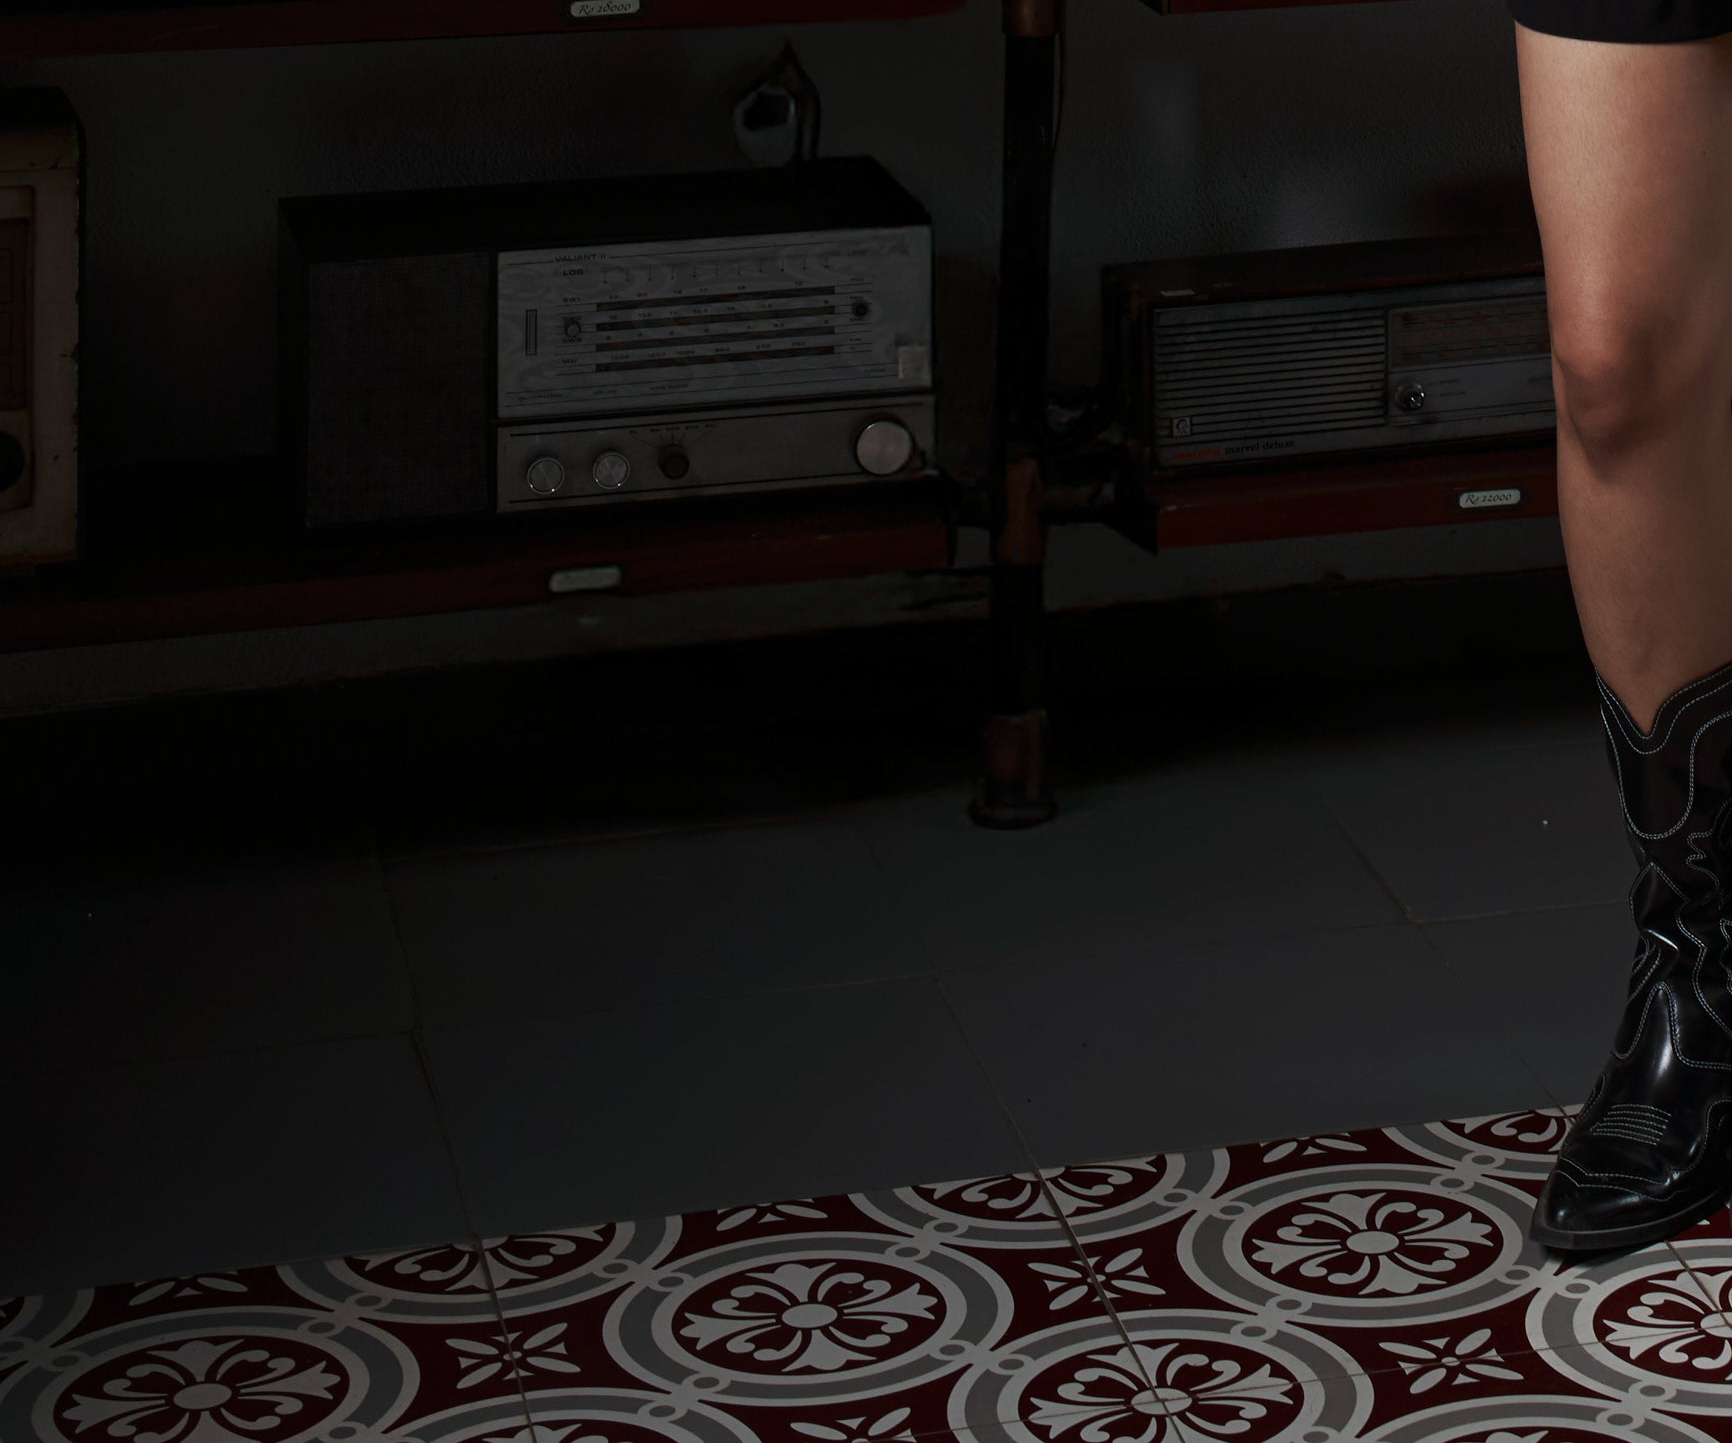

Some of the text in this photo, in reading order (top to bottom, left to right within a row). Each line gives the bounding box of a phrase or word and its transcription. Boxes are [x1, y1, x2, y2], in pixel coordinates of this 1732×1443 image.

[555, 254, 597, 263] VALIANT
[563, 268, 585, 277] LOG
[1225, 444, 1260, 455] marvel
[1262, 439, 1297, 451] deluxe
